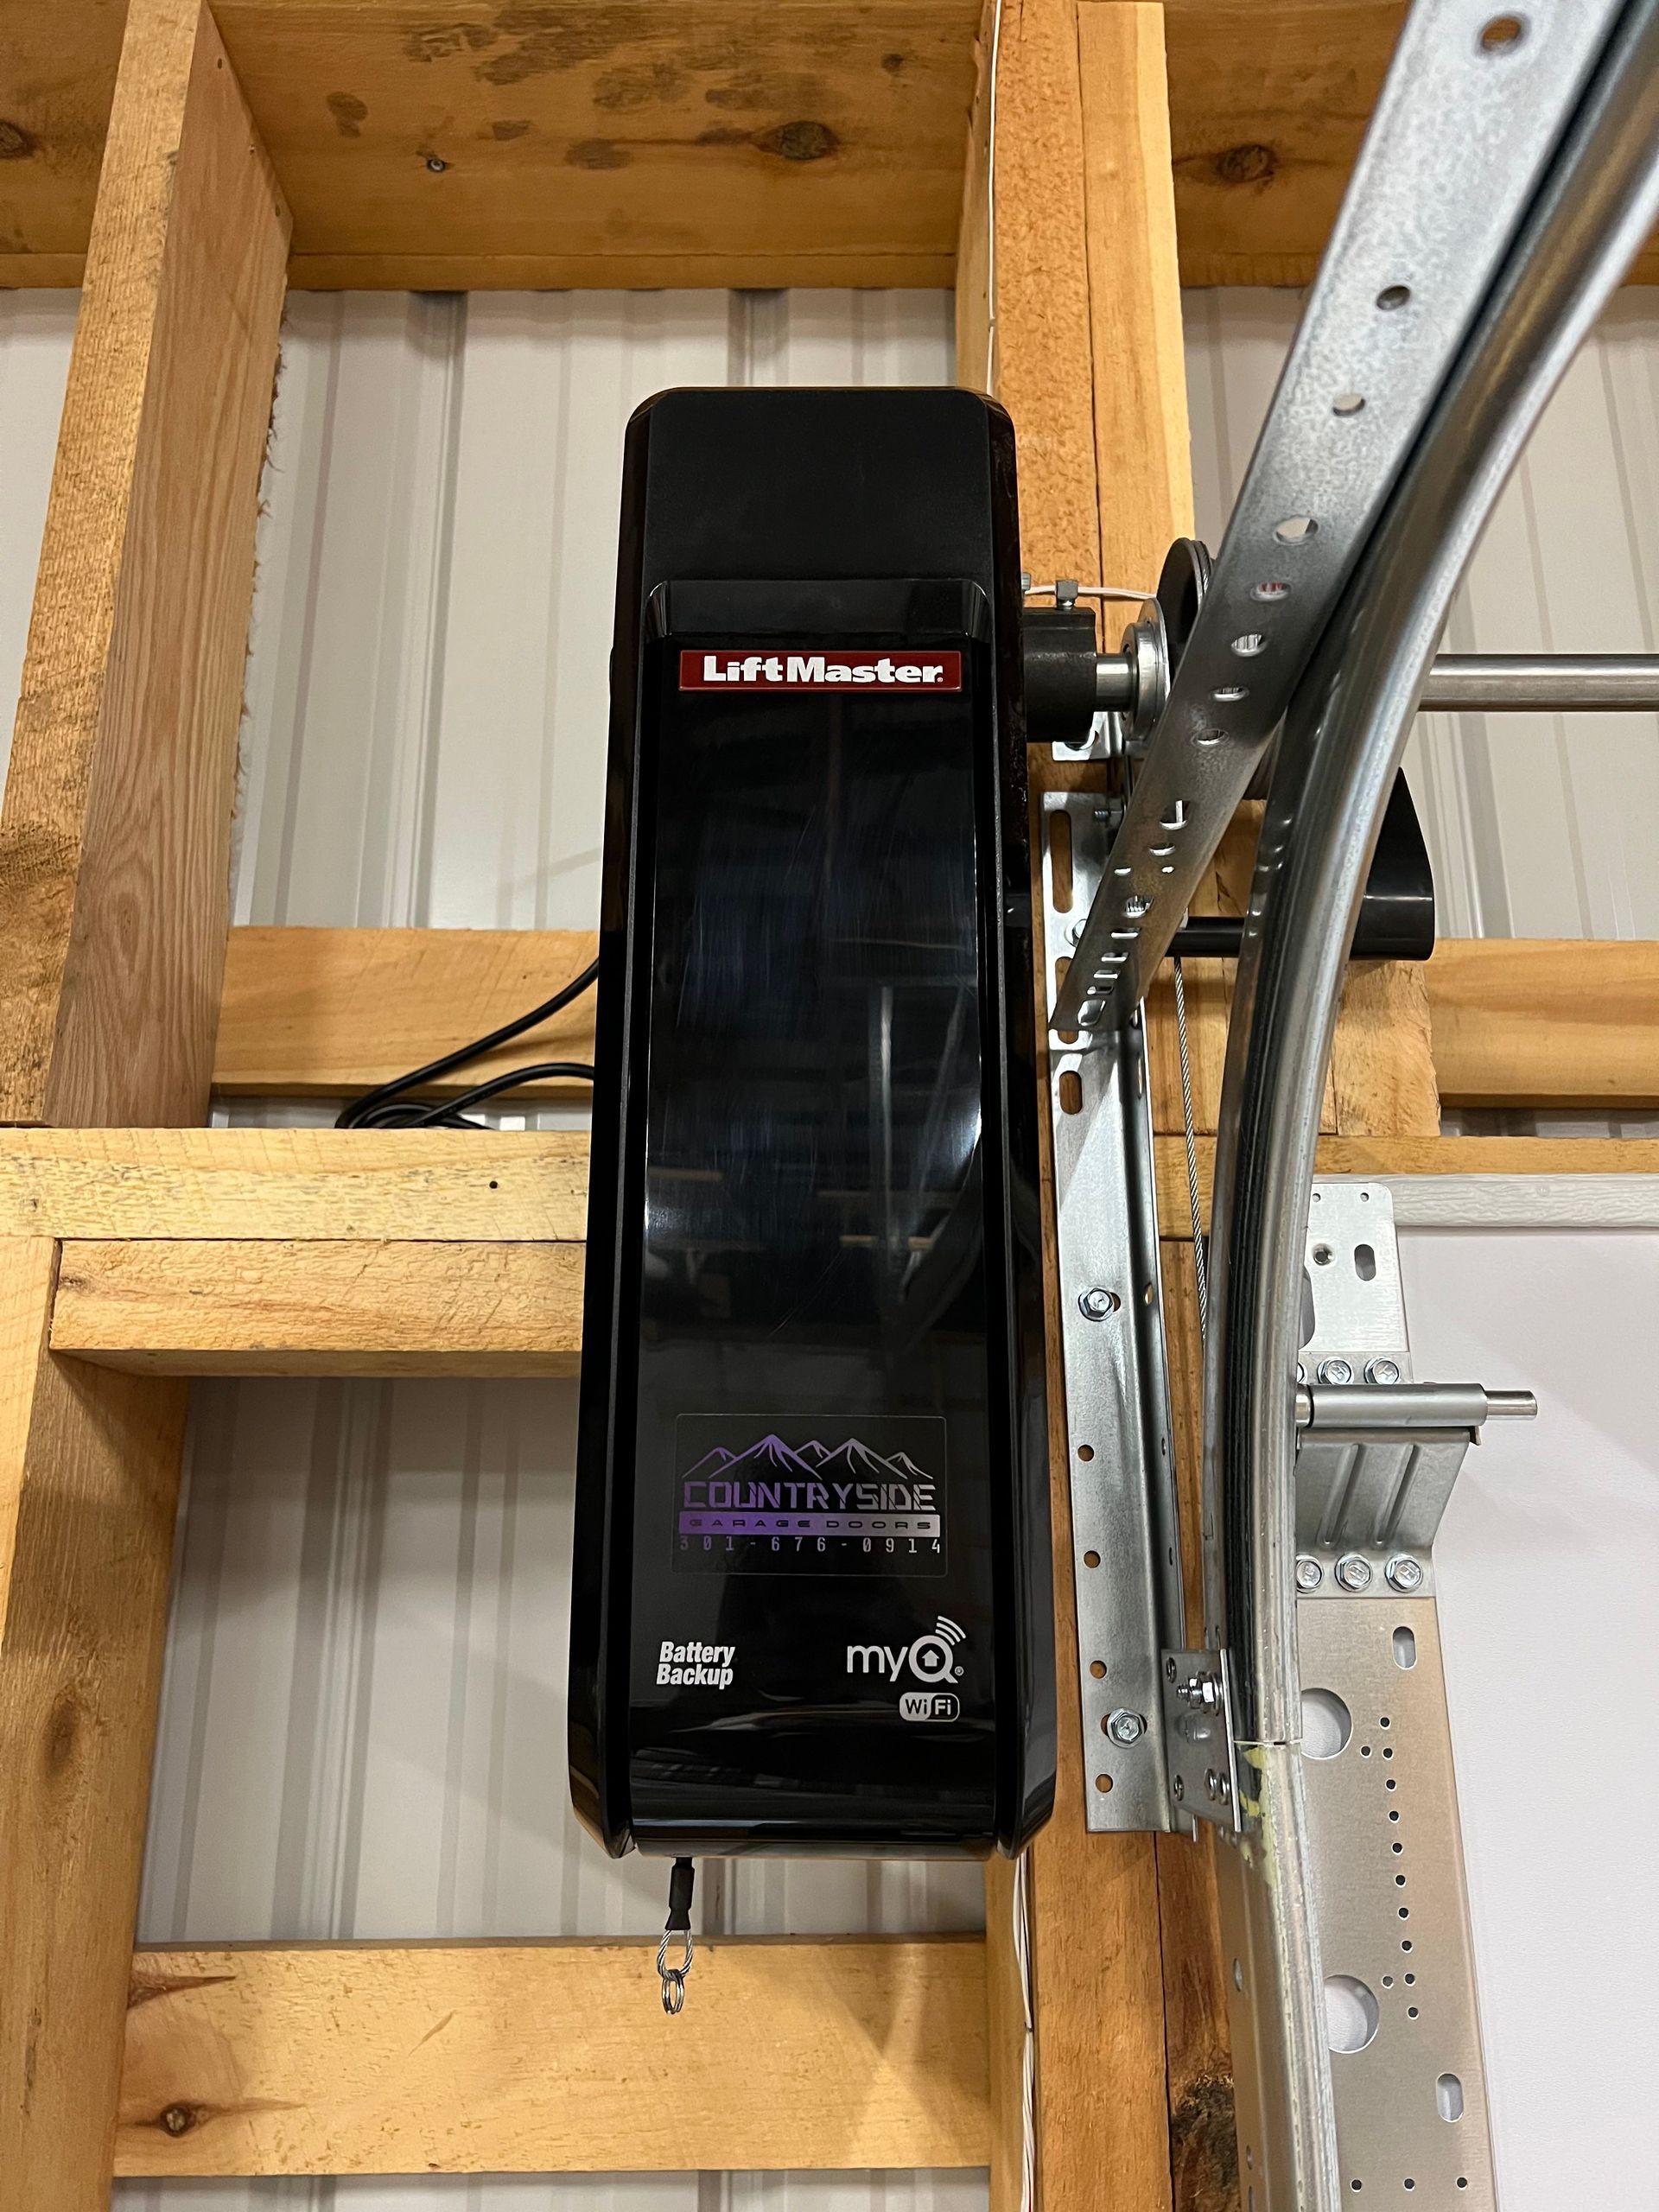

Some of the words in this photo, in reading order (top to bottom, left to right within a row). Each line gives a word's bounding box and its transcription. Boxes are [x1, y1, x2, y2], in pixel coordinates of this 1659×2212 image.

[703, 655, 944, 683] LiftMaster
[683, 1481, 937, 1511] COUNTRYSIDE
[689, 1518, 811, 1529] GARAGE
[826, 1519, 931, 1529] DOORS
[659, 1641, 735, 1667] Battery
[846, 1635, 958, 1684] myQ
[656, 1663, 734, 1690] Backup
